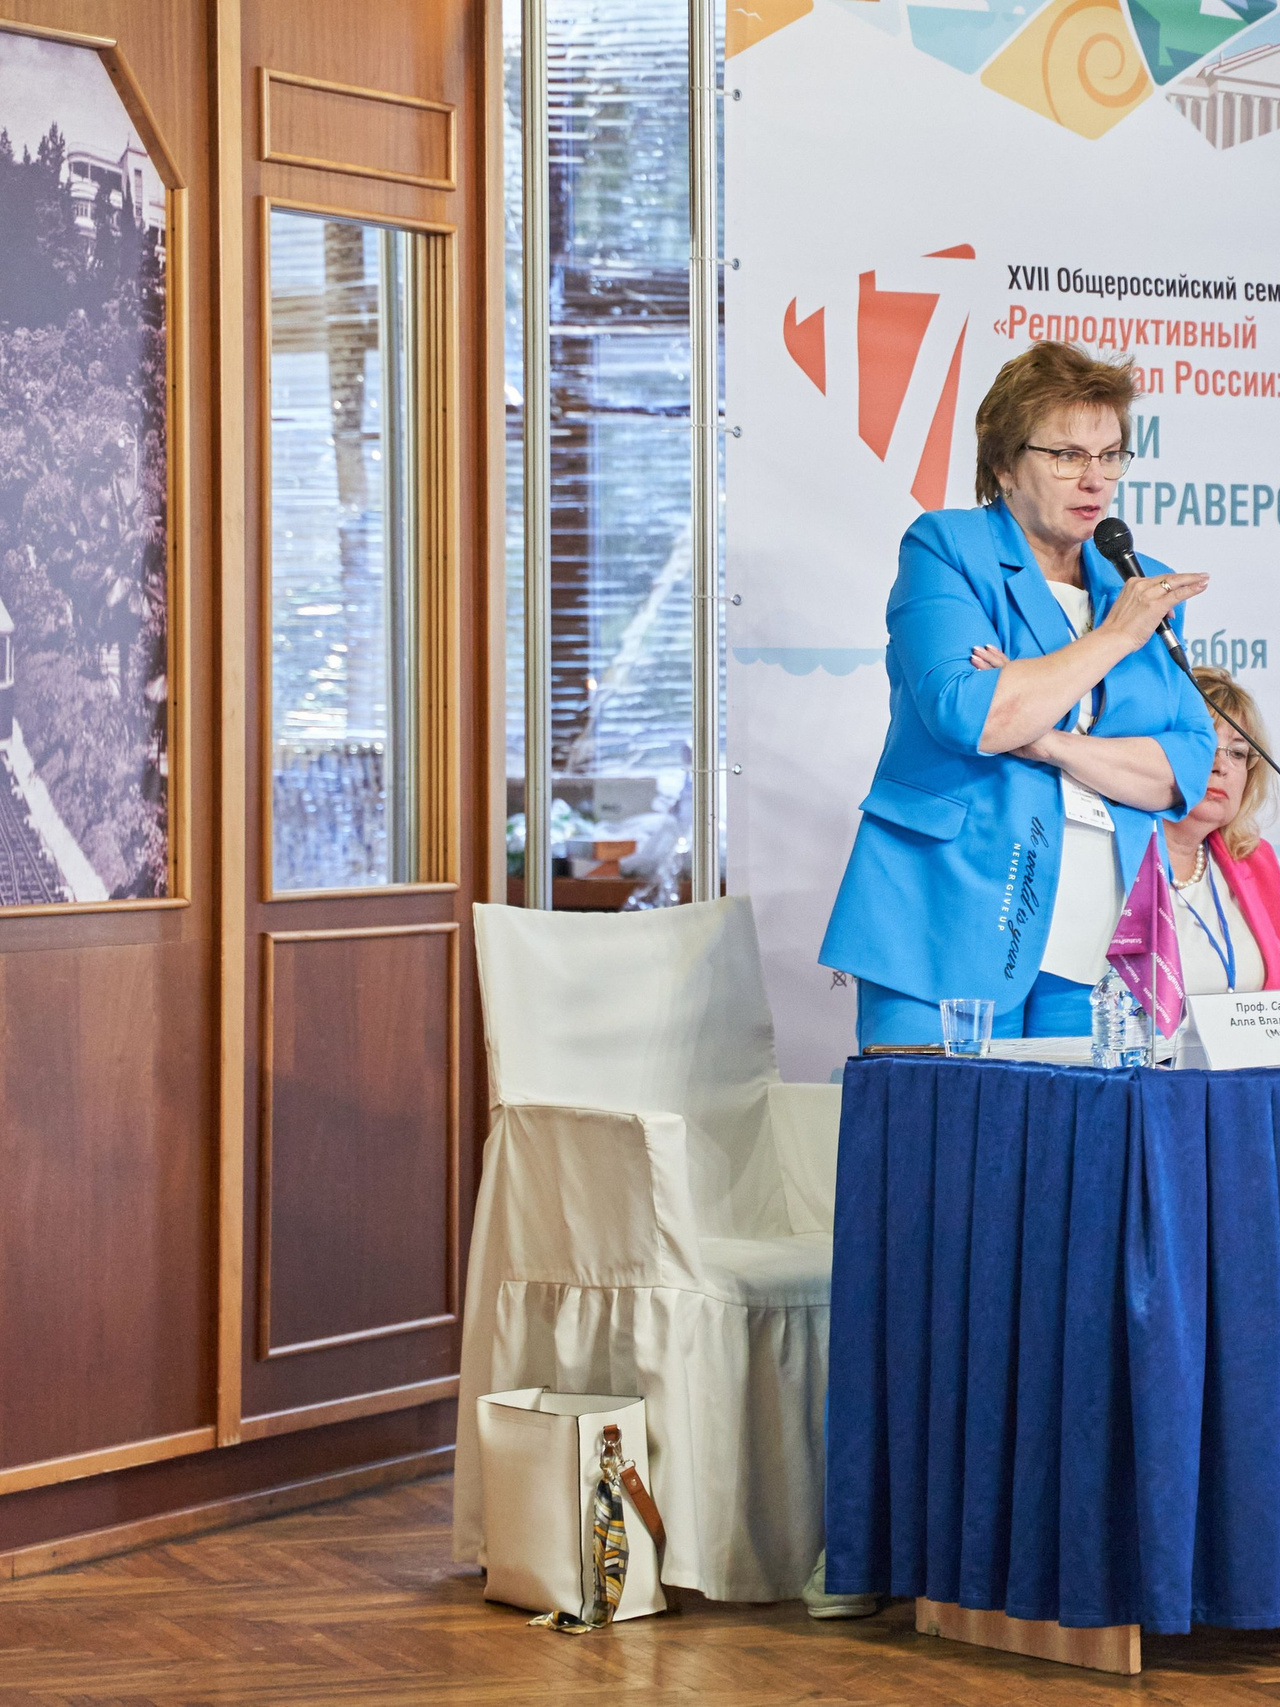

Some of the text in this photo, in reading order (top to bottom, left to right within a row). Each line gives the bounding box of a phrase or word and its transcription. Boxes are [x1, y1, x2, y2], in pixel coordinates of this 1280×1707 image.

[1007, 265, 1050, 292] XVII
[1057, 267, 1237, 301] Общероссийский
[993, 304, 1257, 350] «Репродуктивный
[1190, 629, 1268, 678] ября
[1031, 816, 1049, 848] the
[997, 842, 1021, 932] NEVER GIVE UP
[1021, 850, 1040, 916] world
[1004, 919, 1021, 981] yours
[1230, 1017, 1256, 1027] Алла
[1236, 1001, 1268, 1014] Проф.
